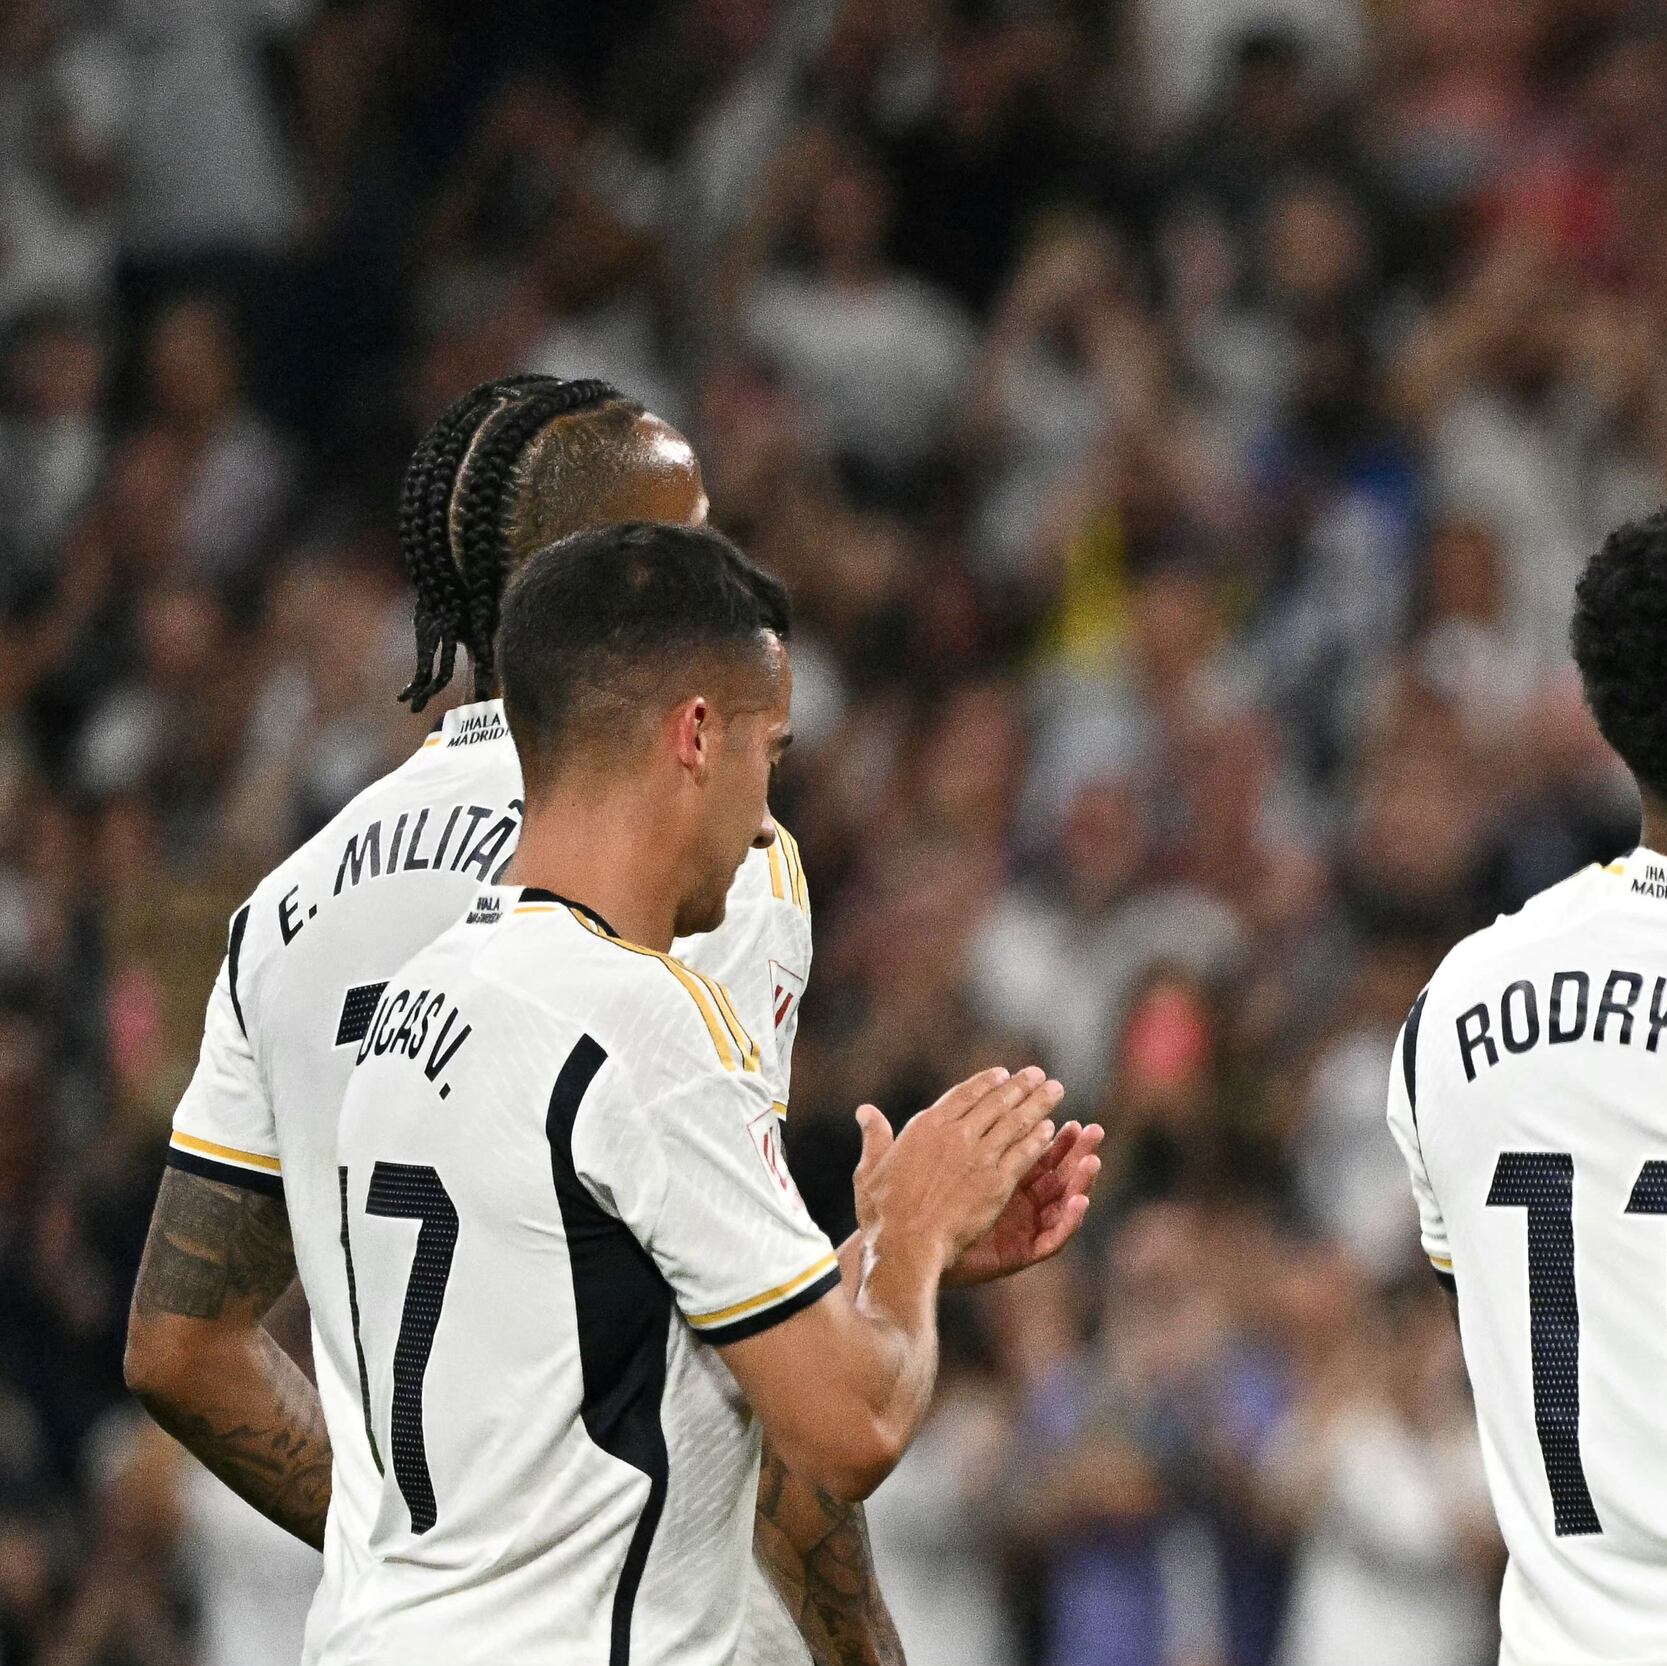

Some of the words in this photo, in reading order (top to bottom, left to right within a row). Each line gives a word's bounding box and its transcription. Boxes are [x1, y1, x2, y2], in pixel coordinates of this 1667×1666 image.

[278, 885, 318, 946] E.
[356, 989, 446, 1066] UCAS
[424, 1007, 472, 1100] V.
